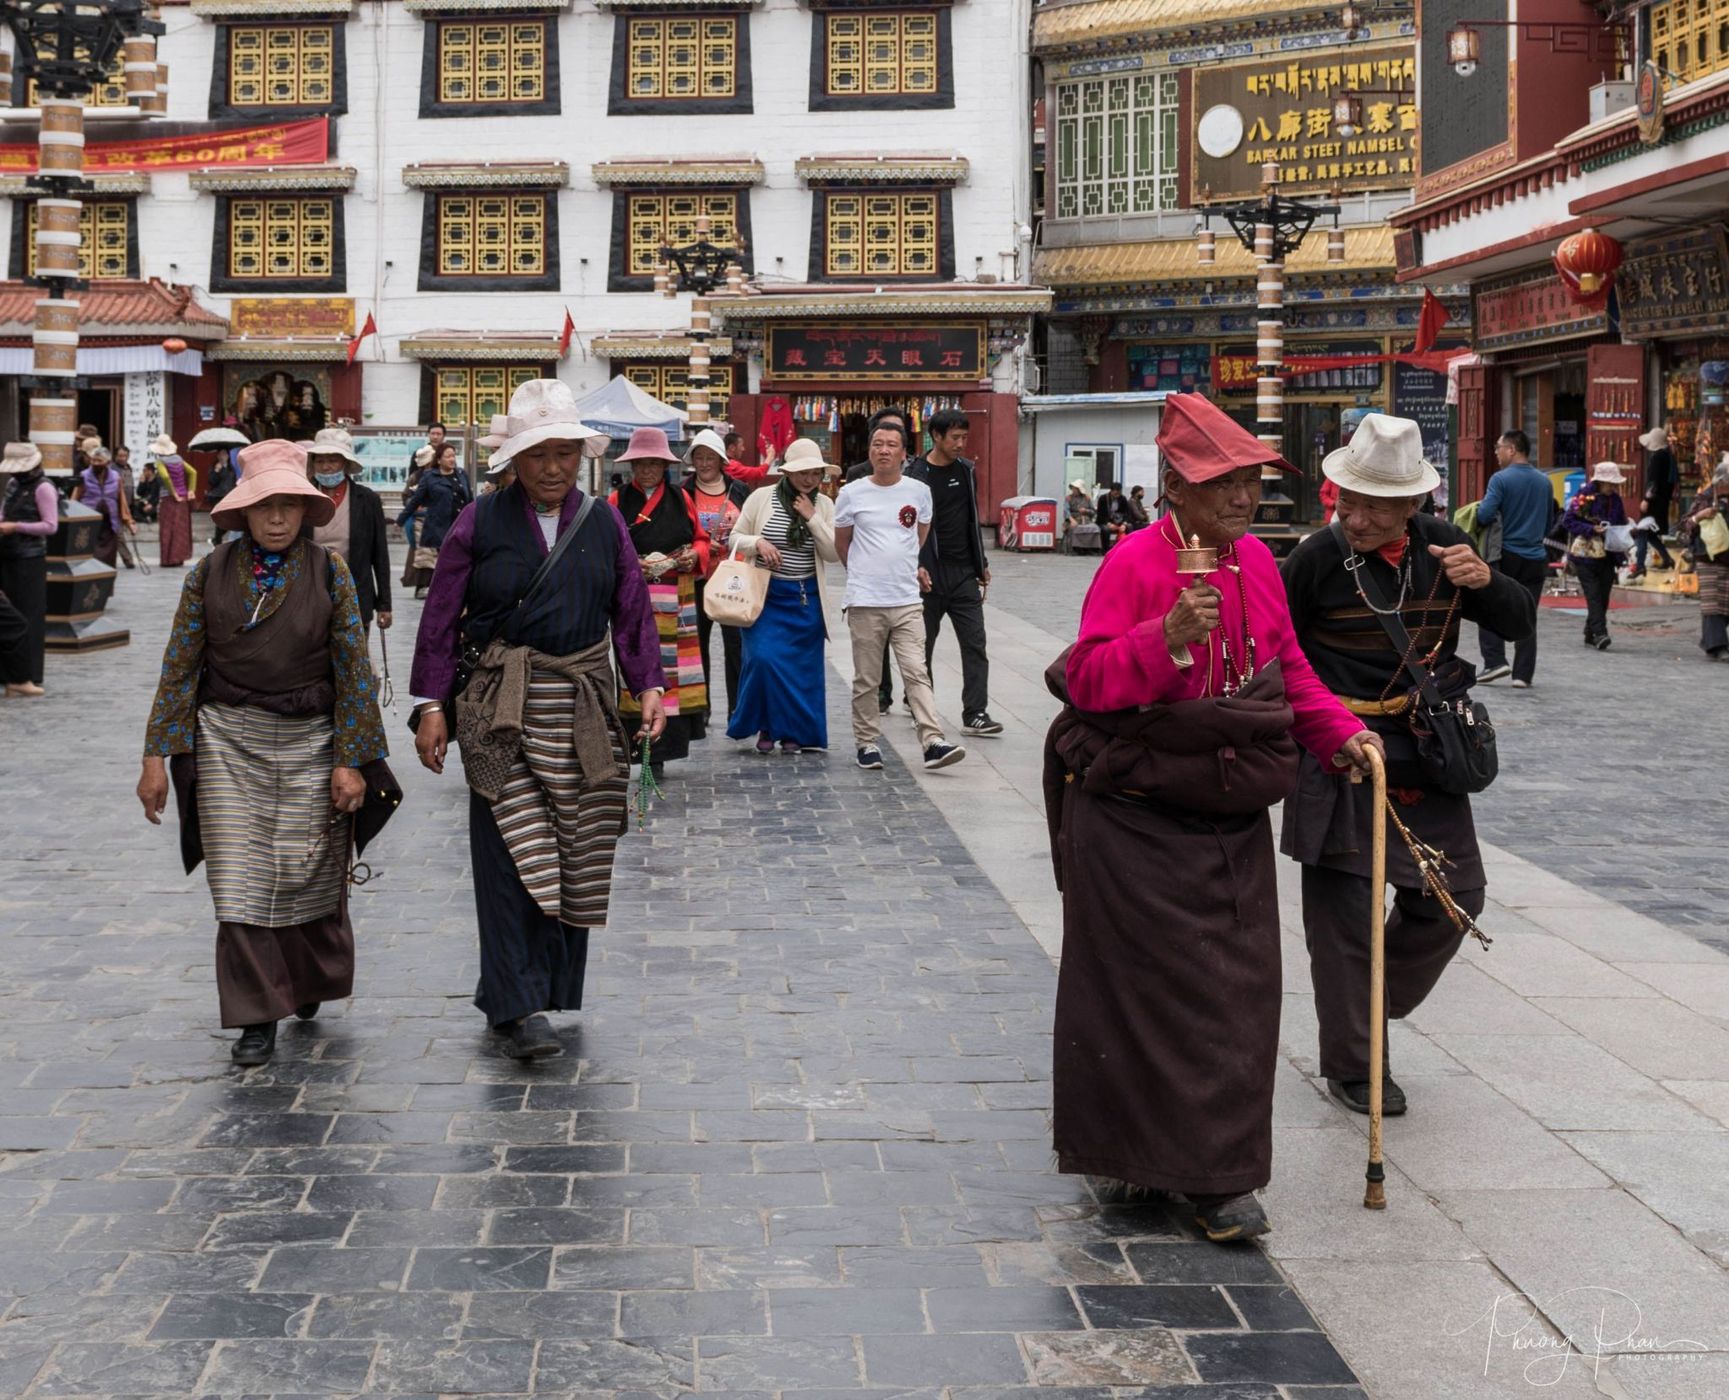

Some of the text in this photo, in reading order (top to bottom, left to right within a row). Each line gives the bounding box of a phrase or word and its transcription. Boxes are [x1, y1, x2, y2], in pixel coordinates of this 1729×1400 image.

[1303, 143, 1342, 159] STEET
[1347, 137, 1405, 155] NAMSEL
[785, 348, 964, 367] 藏宝天眼石
